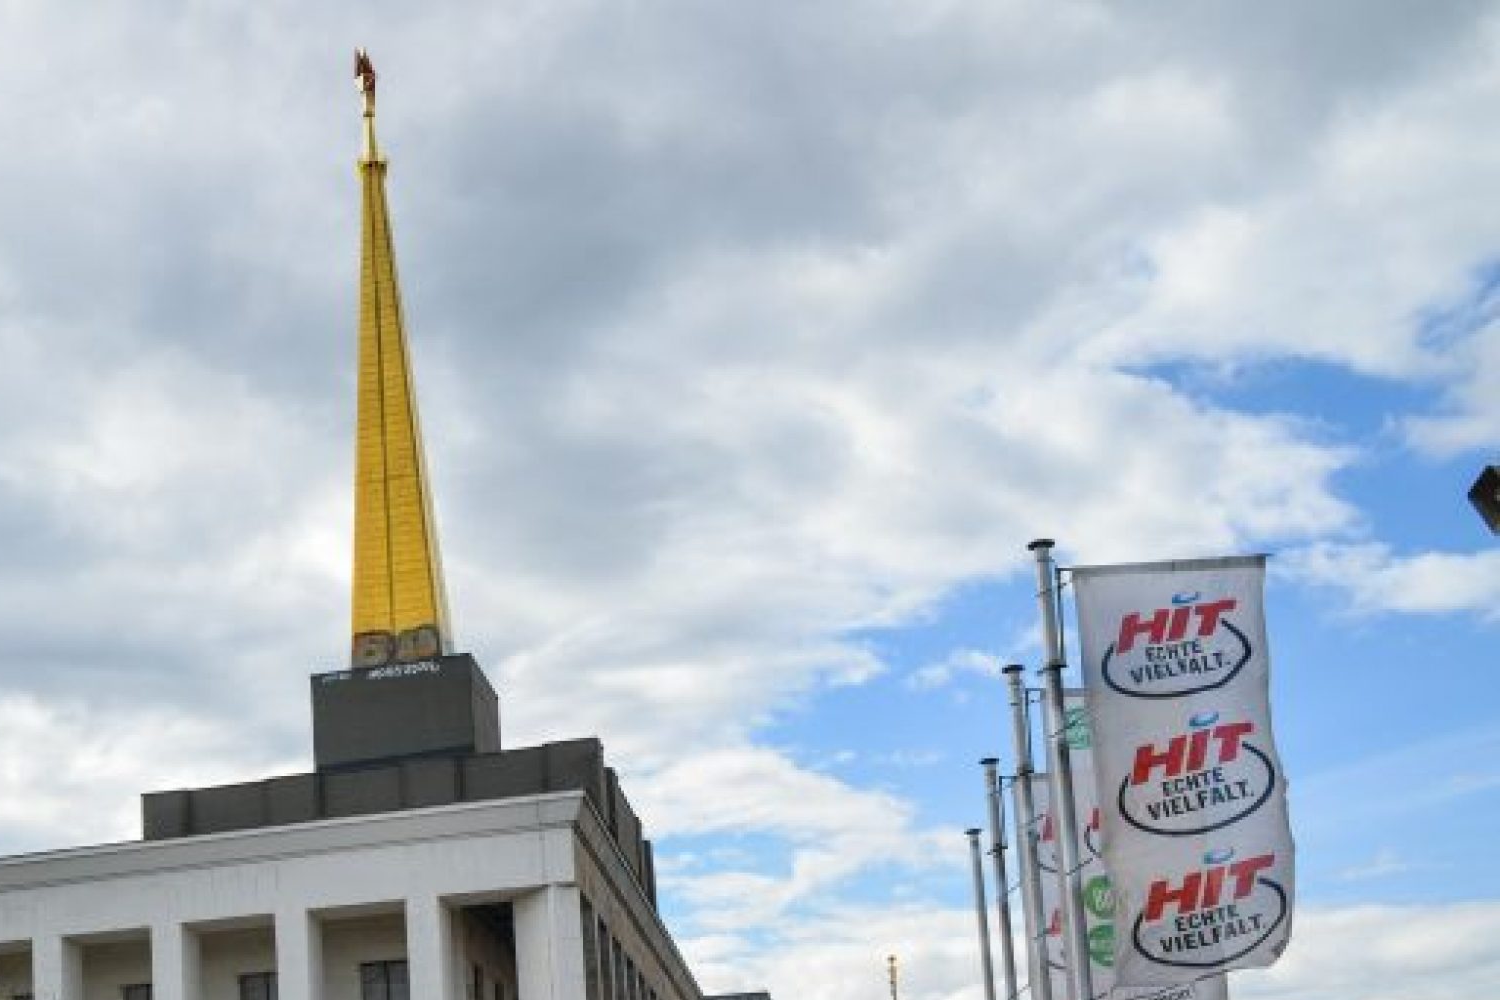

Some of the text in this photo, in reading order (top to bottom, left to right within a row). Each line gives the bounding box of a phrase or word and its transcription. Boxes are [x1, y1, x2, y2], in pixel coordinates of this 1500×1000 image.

[1116, 592, 1237, 656] HIT
[1131, 711, 1254, 785] HIT
[1162, 767, 1224, 796] ECHTE
[1145, 847, 1275, 923] HIT
